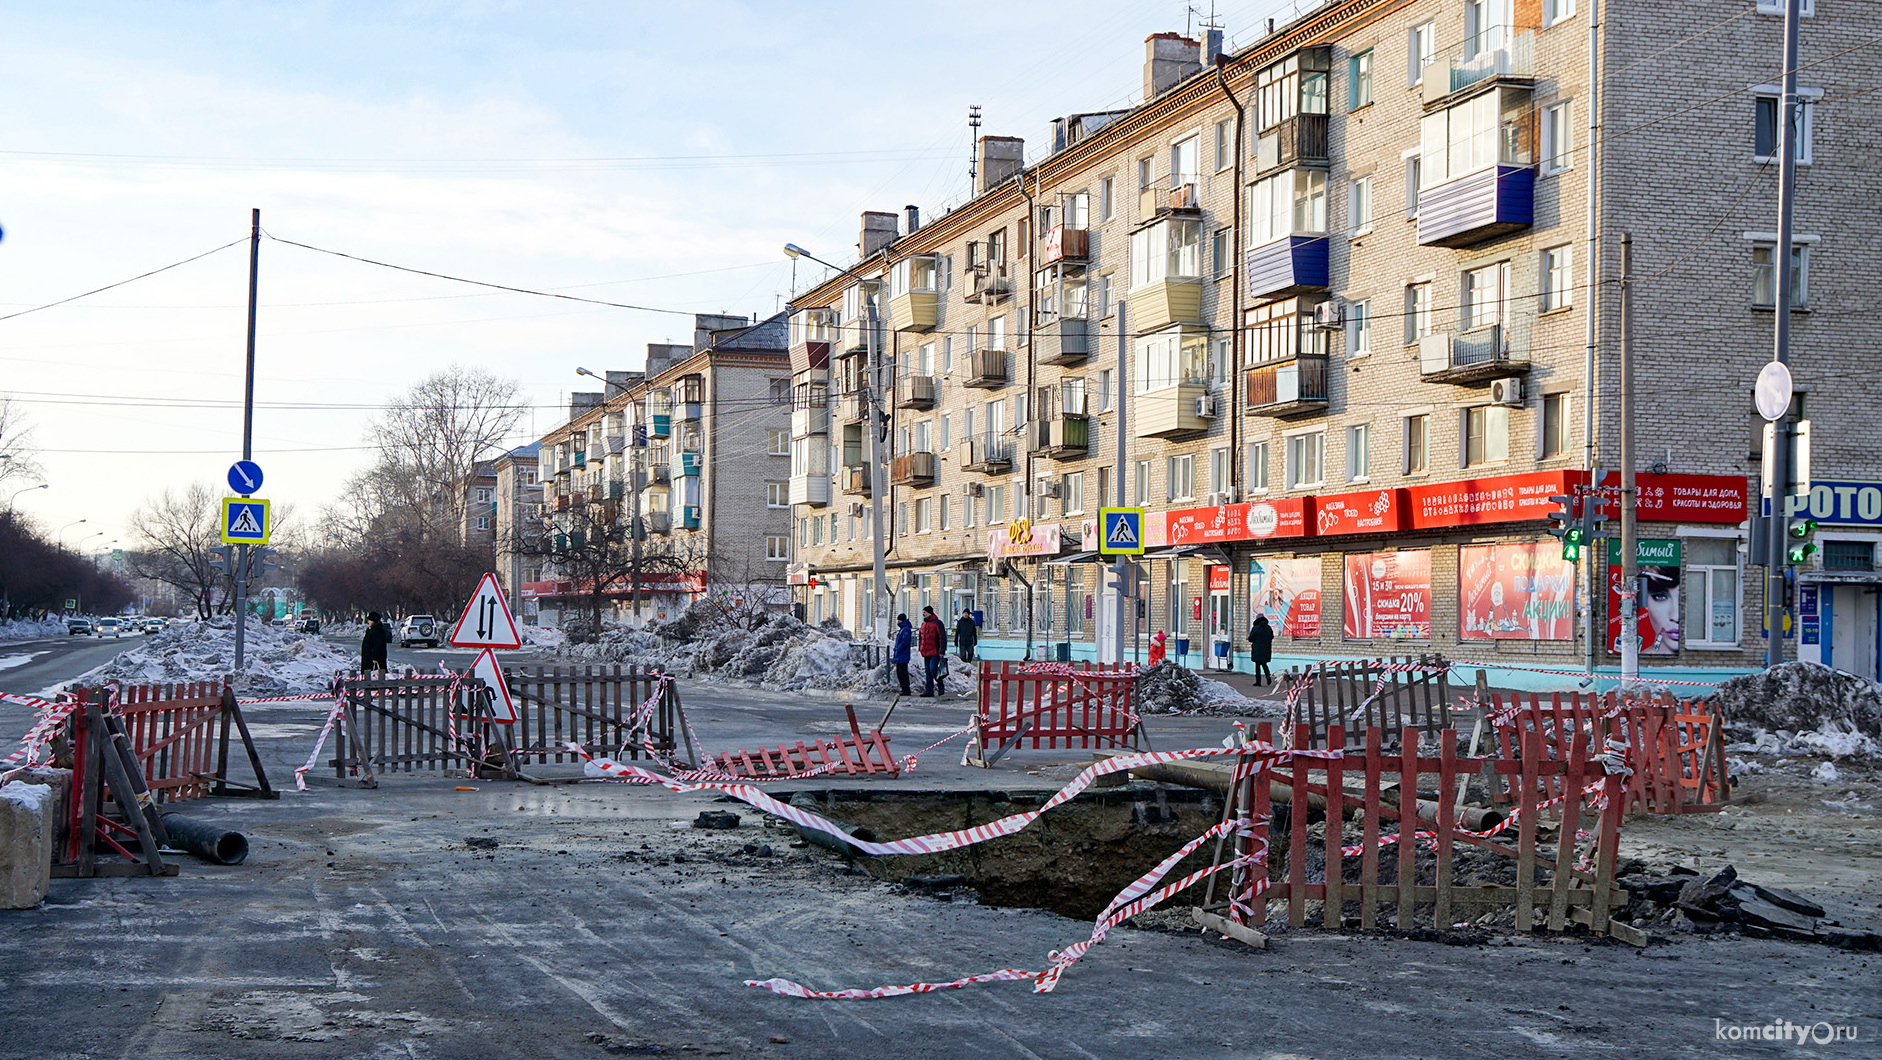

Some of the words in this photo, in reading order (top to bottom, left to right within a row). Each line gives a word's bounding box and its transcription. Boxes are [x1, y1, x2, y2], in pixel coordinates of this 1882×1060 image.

[1673, 487, 1701, 497] ТОВАРЫ
[1702, 488, 1718, 497] ДЛЯ
[1719, 489, 1741, 499] ДОМА,
[1672, 499, 1701, 508] КРАСОТЫ
[1701, 500, 1707, 508] И
[1708, 500, 1743, 510] ЗДОРОВЬЯ
[1570, 530, 1579, 541] 9
[1615, 541, 1674, 558] бимый
[1511, 552, 1562, 572] СКИДКИ!
[1372, 580, 1381, 592] 15
[1385, 580, 1393, 592] 30
[1513, 575, 1570, 593] ПОДАРКИ!
[1400, 591, 1425, 613] 20%
[1522, 600, 1571, 623] АКЦИИ!
